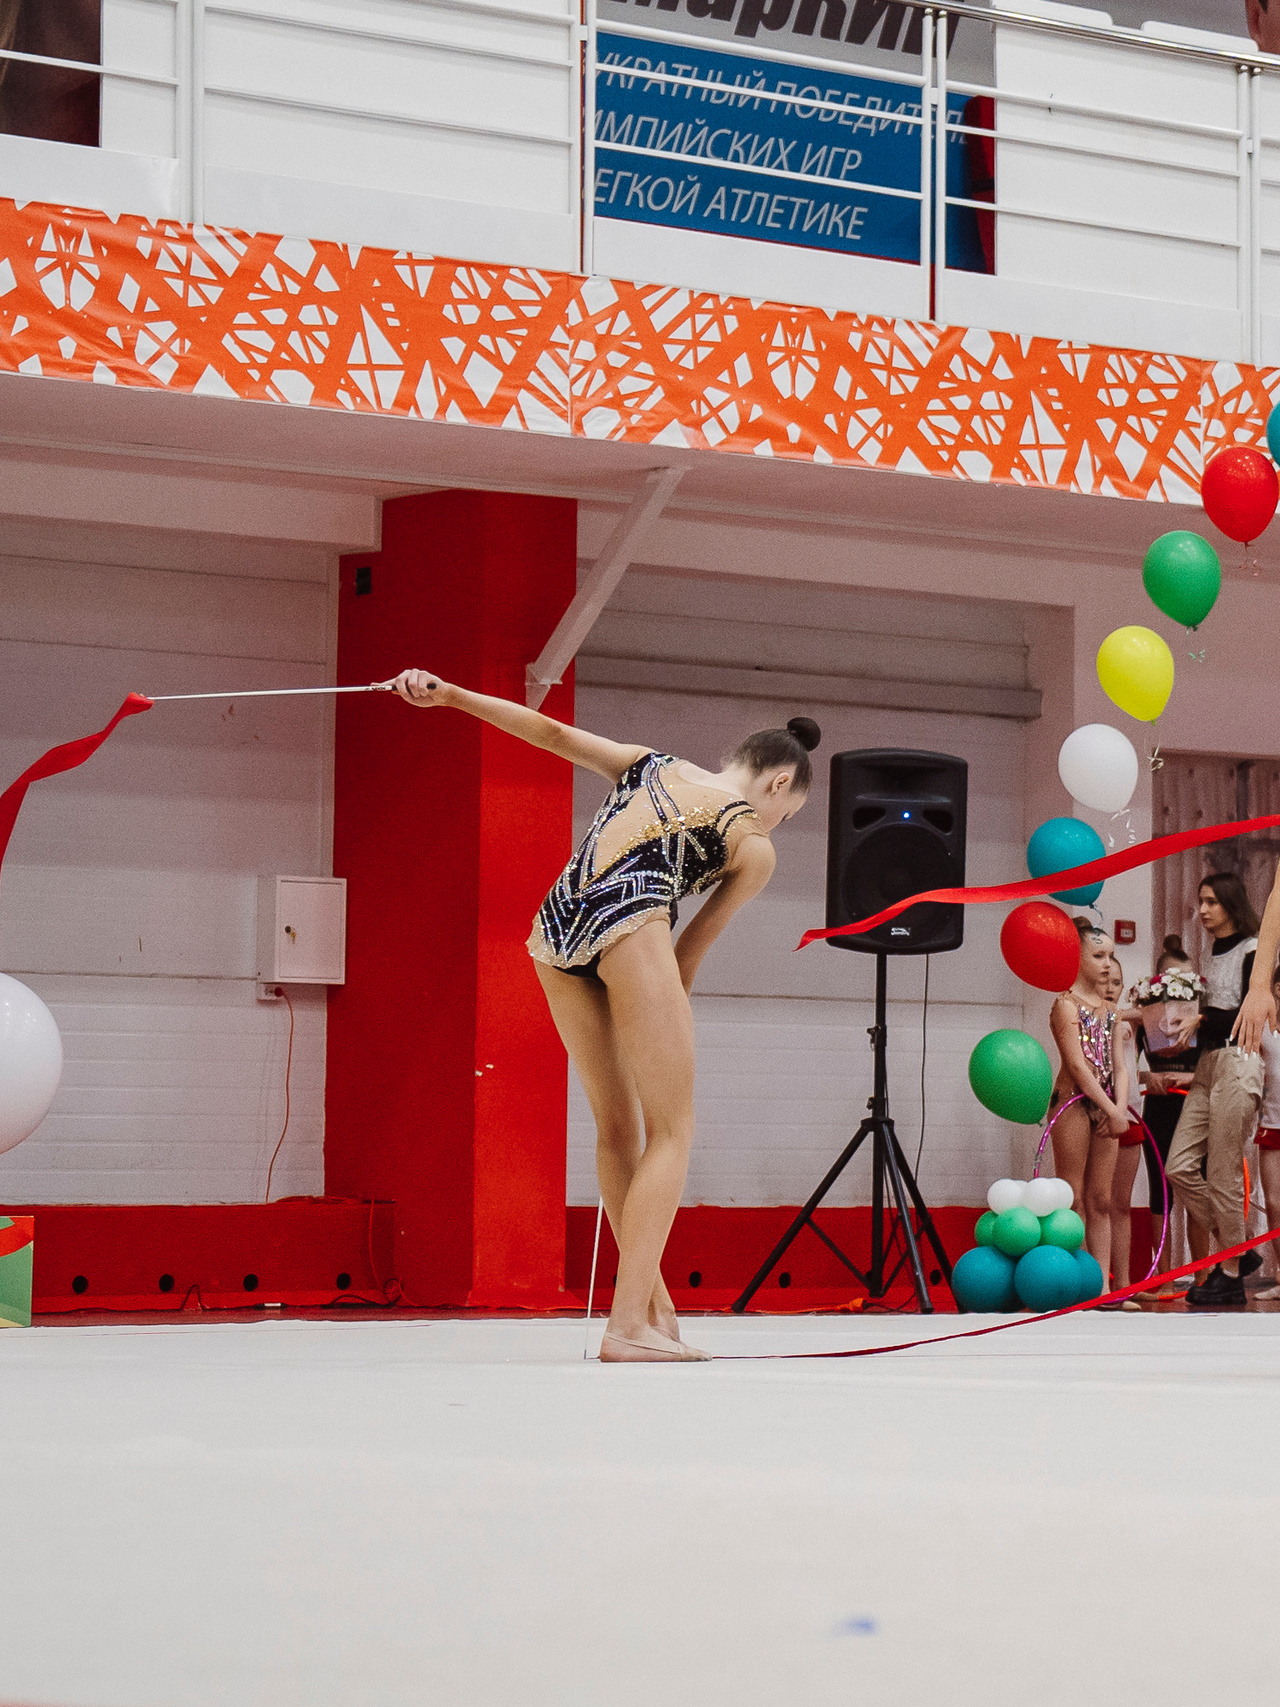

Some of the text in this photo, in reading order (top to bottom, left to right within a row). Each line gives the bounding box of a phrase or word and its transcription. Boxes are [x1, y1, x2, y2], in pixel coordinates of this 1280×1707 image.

[770, 81, 967, 144] ПОБЕДИТЛ
[800, 143, 862, 180] ИГР
[703, 186, 868, 240] АТЛЕТИКЕ
